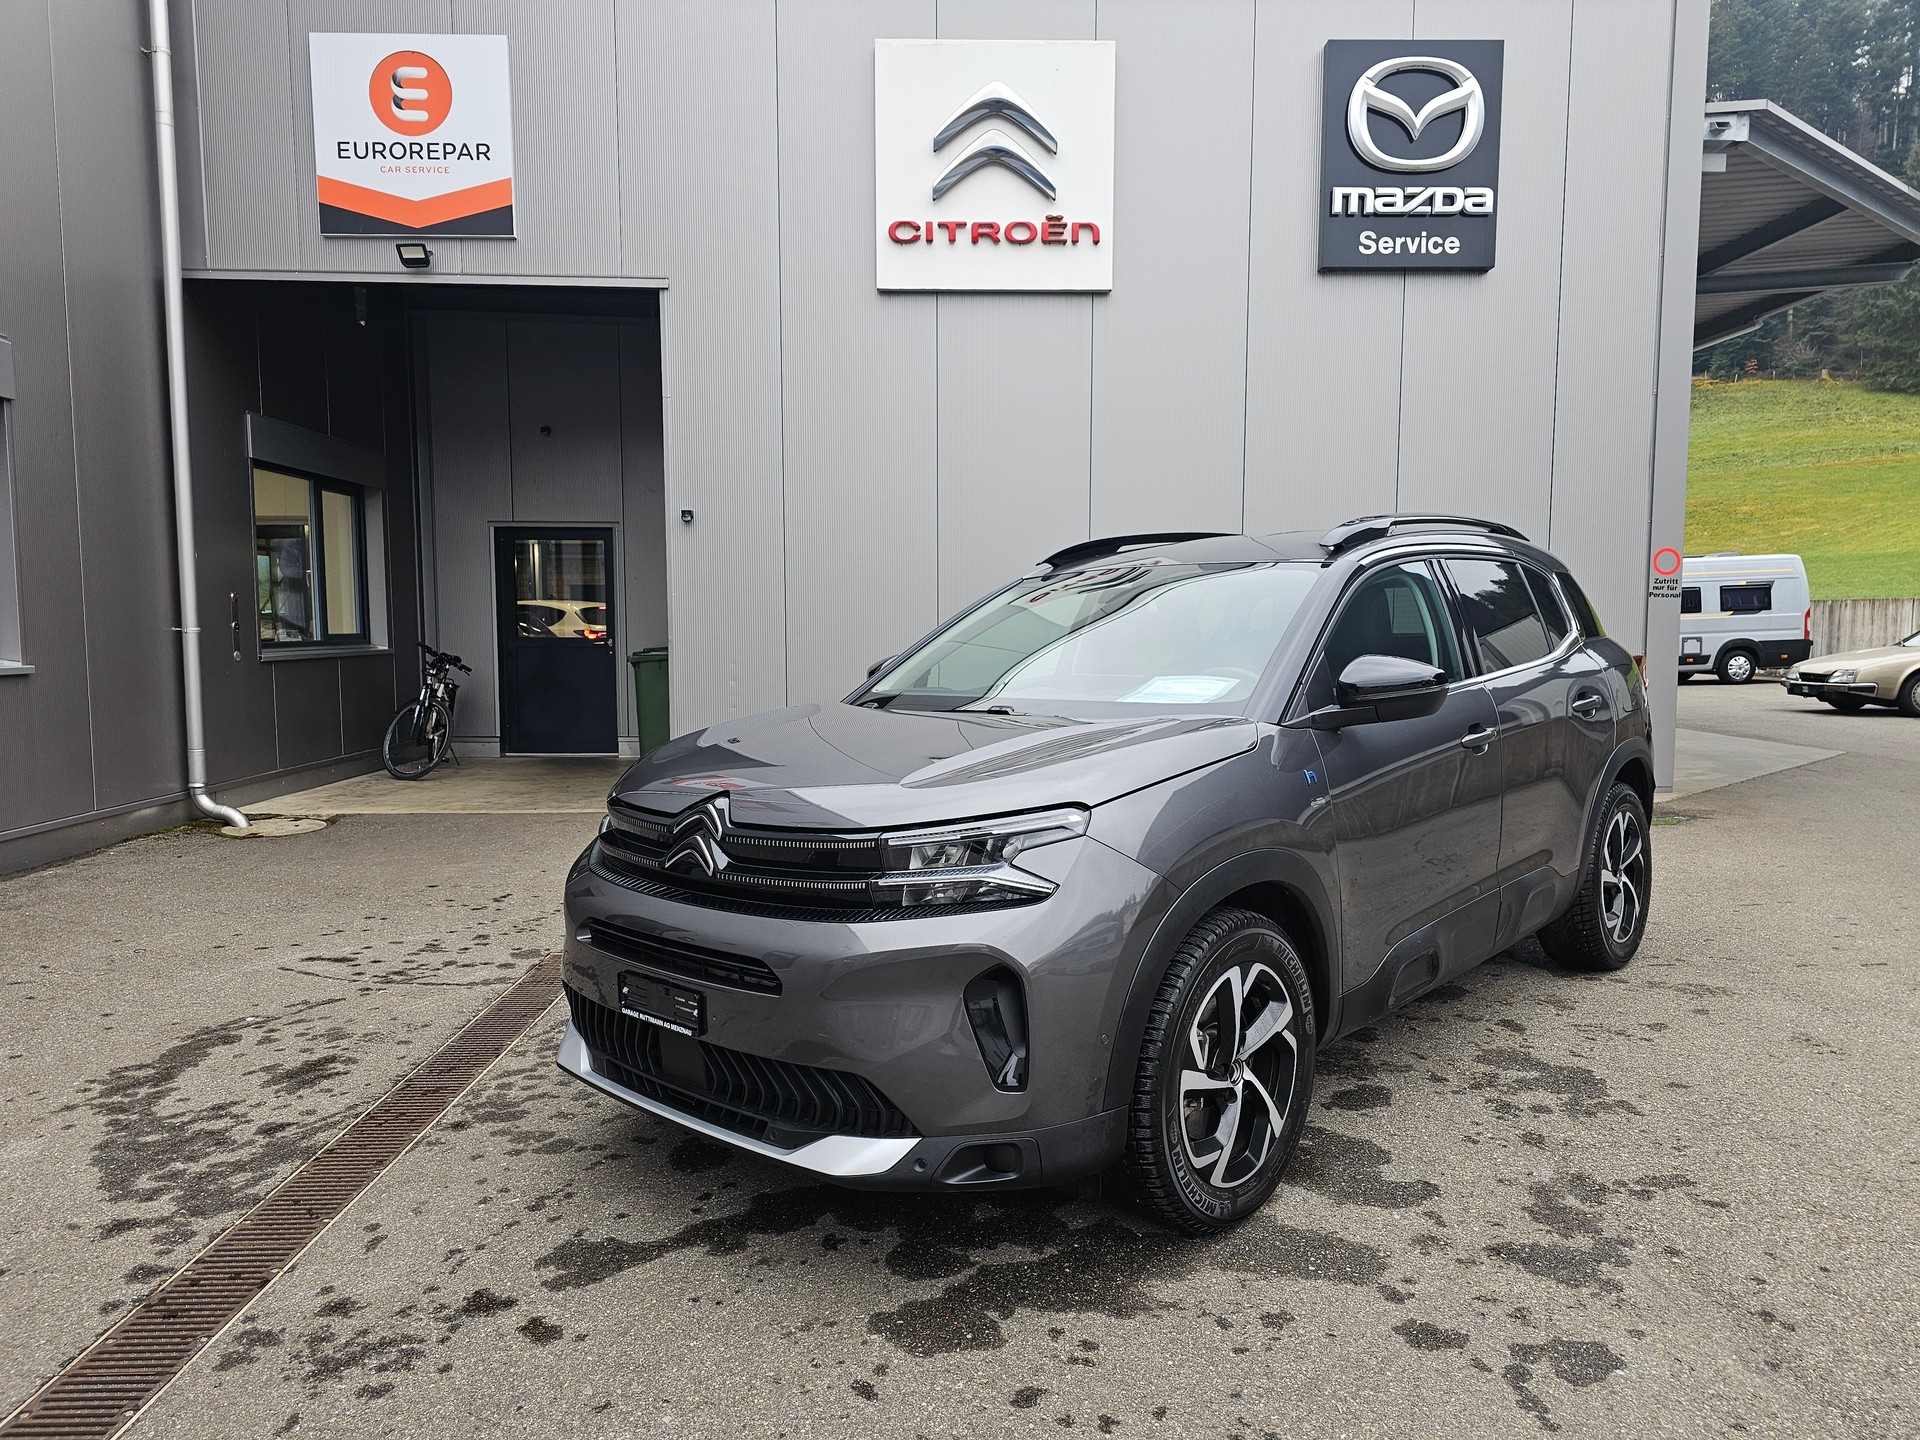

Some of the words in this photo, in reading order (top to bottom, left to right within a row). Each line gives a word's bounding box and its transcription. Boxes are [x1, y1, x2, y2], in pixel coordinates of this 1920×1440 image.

[337, 141, 491, 161] EUROREPAR
[380, 165, 401, 174] CAR
[405, 166, 450, 174] SERVICE
[1358, 230, 1461, 255] Service
[1274, 943, 1311, 1010] MICHELIN
[1172, 1150, 1217, 1215] MICHELIN
